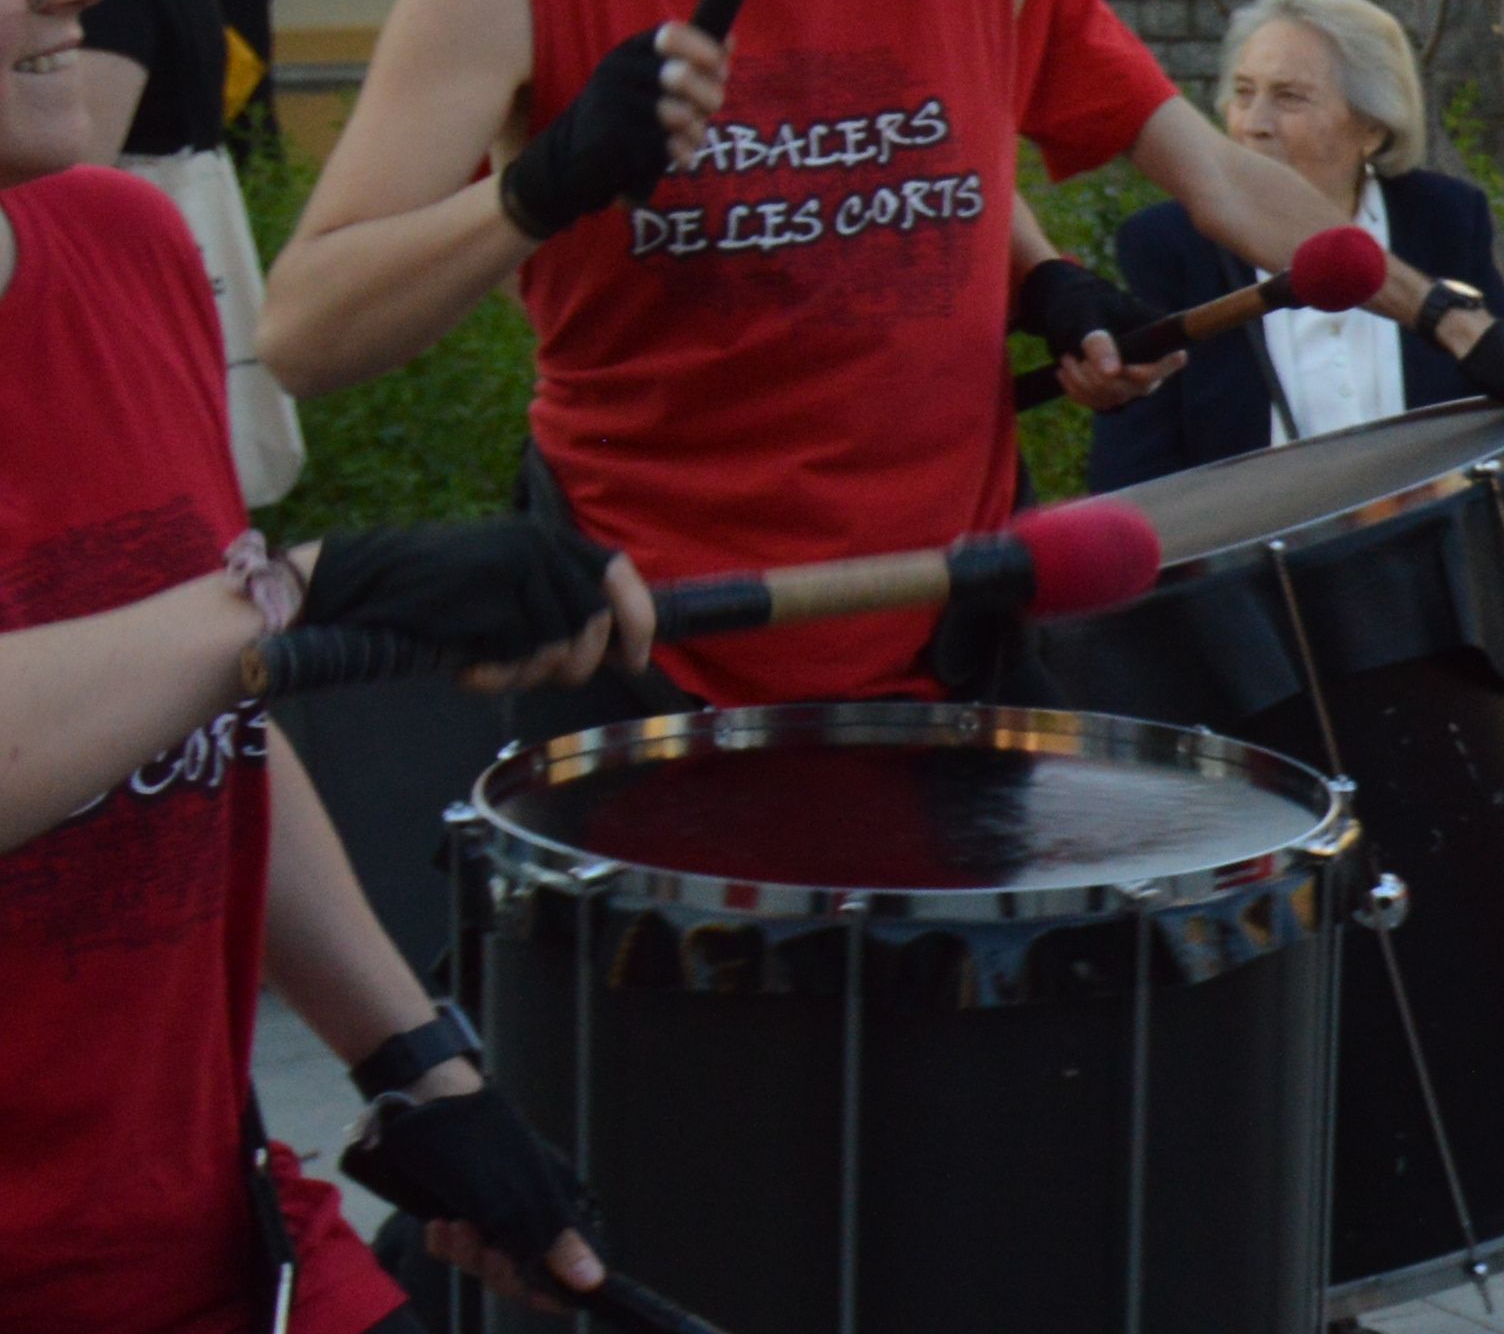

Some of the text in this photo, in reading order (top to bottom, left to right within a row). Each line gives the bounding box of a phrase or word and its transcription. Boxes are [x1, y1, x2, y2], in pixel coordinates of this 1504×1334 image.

[666, 99, 948, 172] ABALERS
[631, 174, 983, 256] DE LES CORTS
